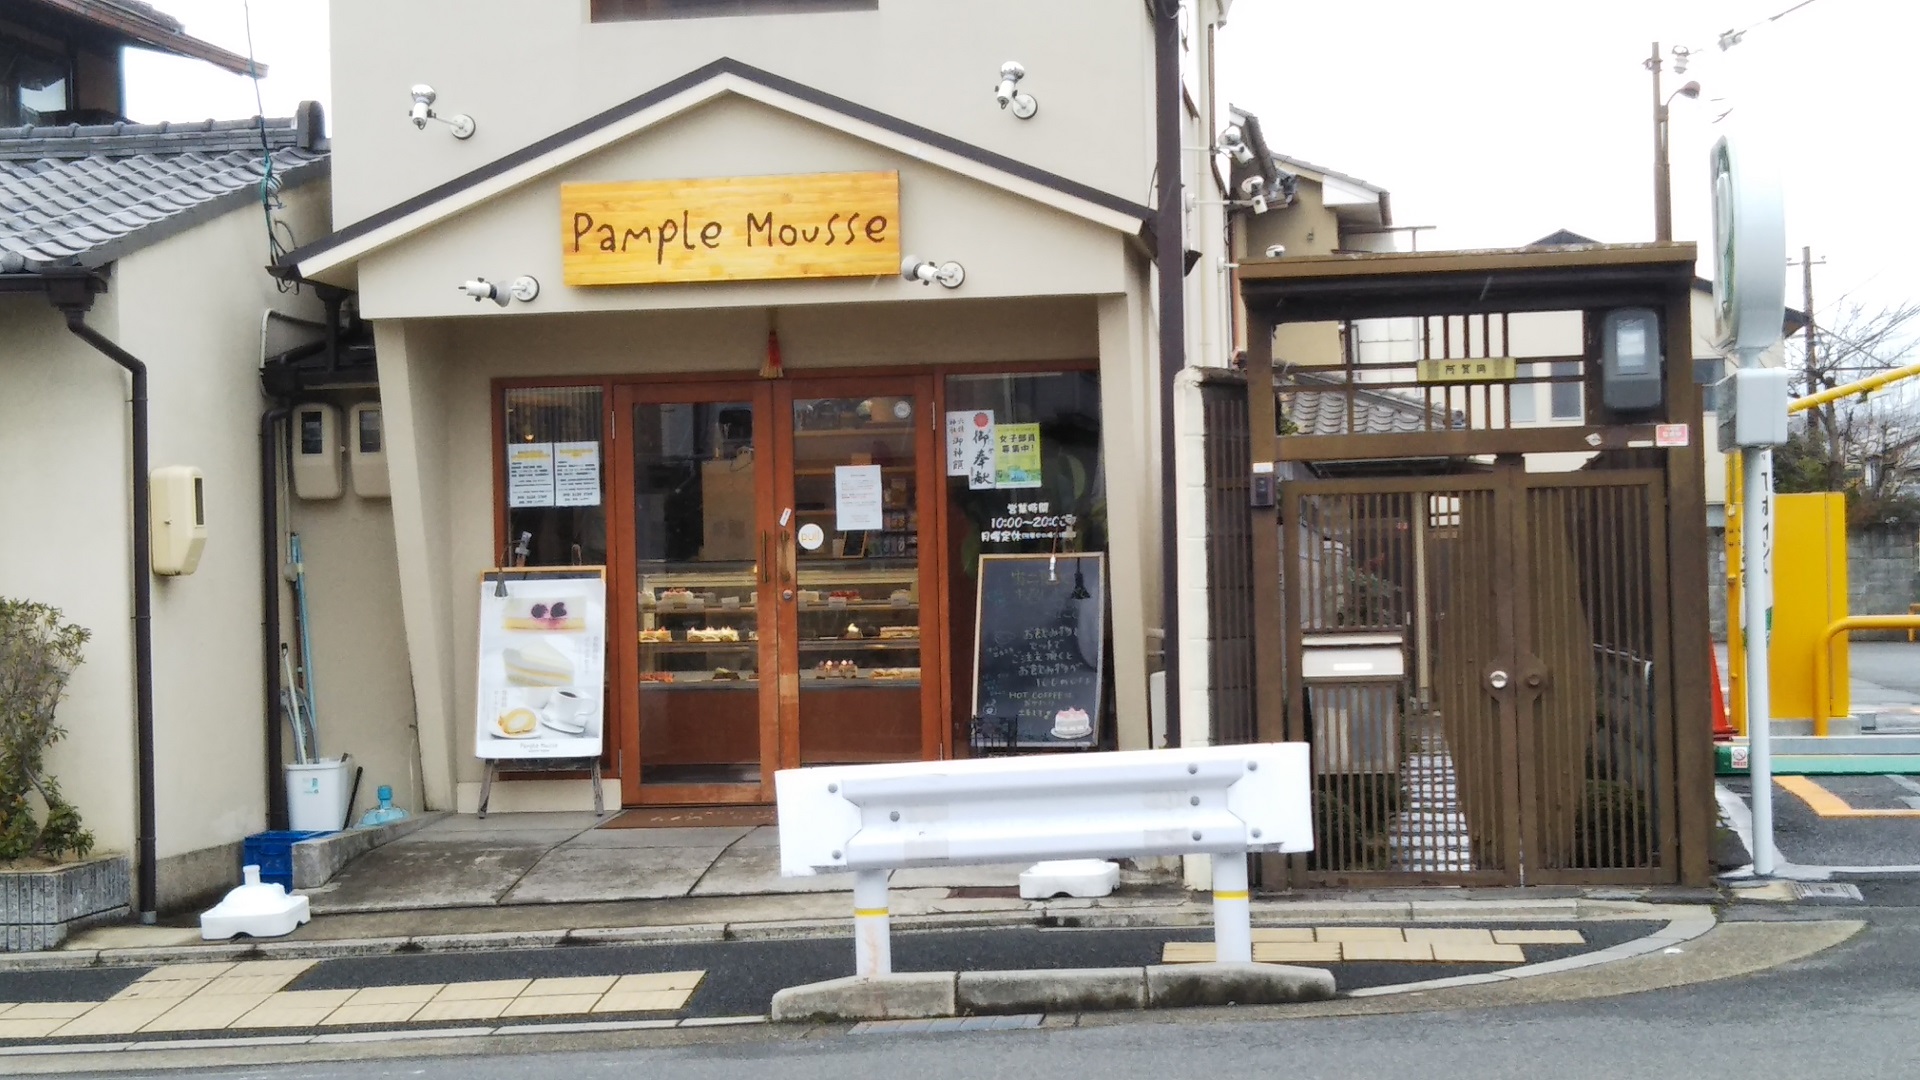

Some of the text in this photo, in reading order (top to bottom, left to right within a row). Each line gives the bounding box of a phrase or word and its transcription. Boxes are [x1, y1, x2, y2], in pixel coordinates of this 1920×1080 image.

[573, 210, 887, 265] Pample Mousse
[1007, 502, 1049, 515] 営業時間
[1009, 691, 1027, 699] HOT
